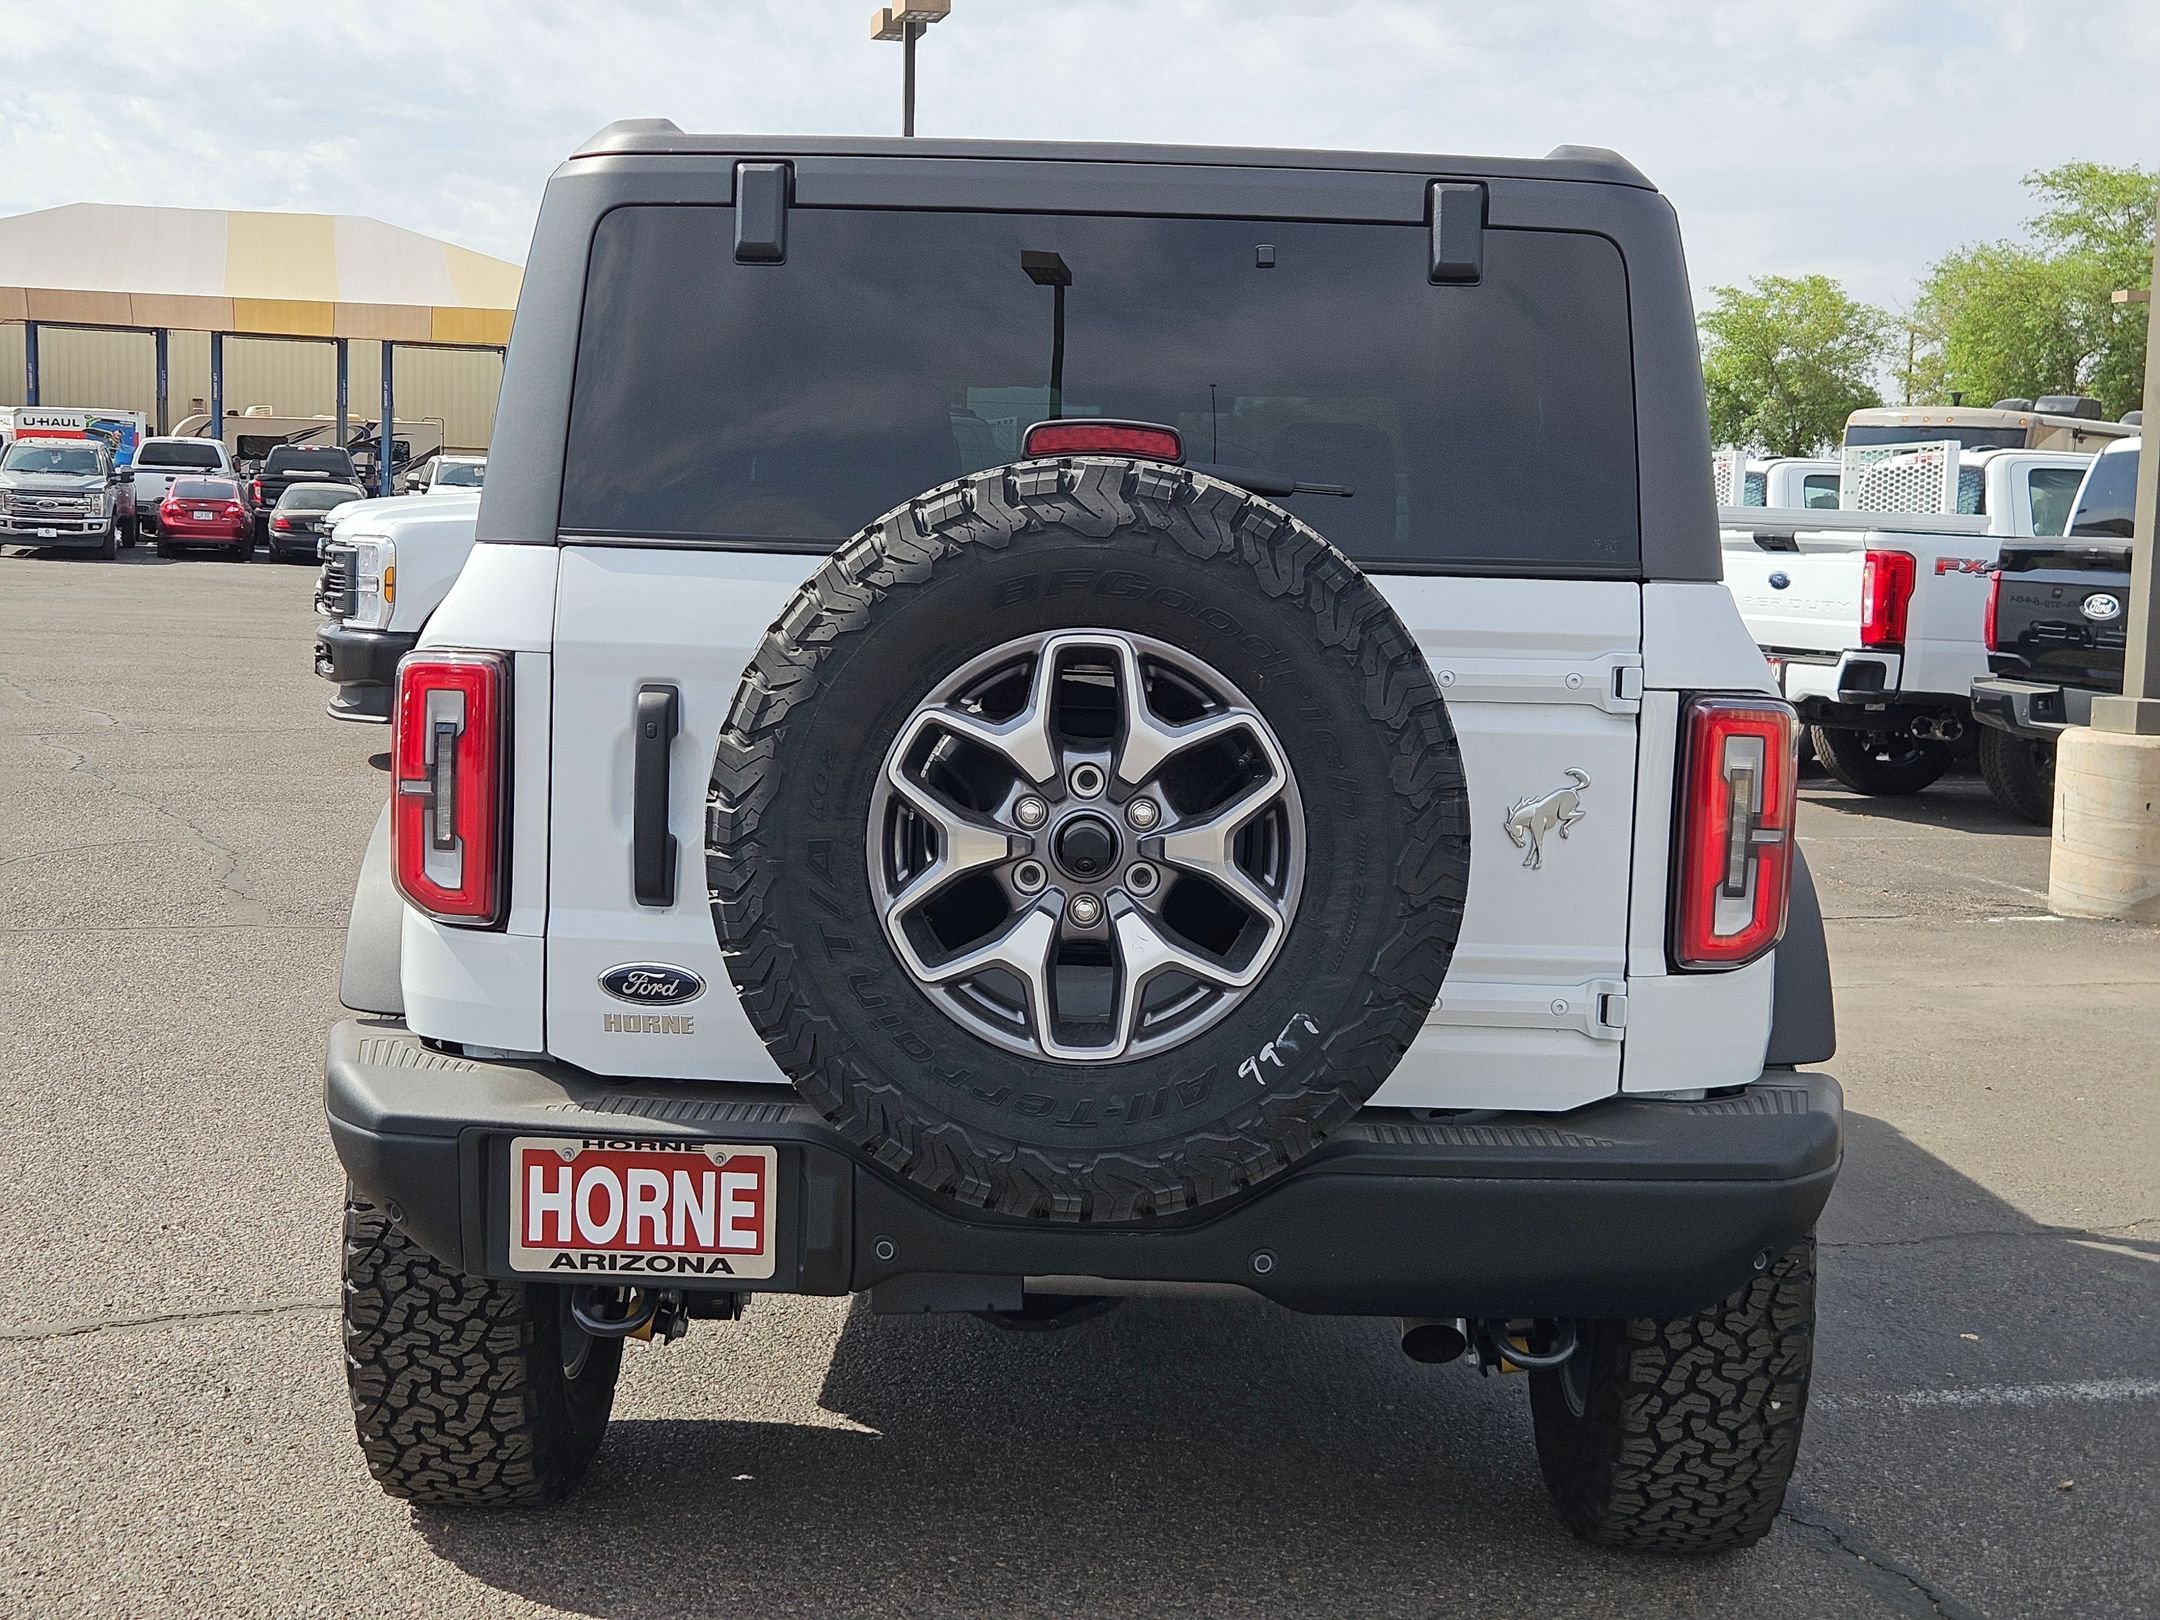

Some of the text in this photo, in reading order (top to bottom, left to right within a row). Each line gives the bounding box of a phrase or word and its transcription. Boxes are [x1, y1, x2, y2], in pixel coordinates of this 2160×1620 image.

[22, 416, 81, 428] U-HAUL
[621, 970, 679, 998] Ford
[602, 1012, 695, 1035] HORNE
[582, 1139, 706, 1153] HORNE
[528, 1165, 758, 1249] HORNE
[548, 1252, 735, 1275] ARIZONA
